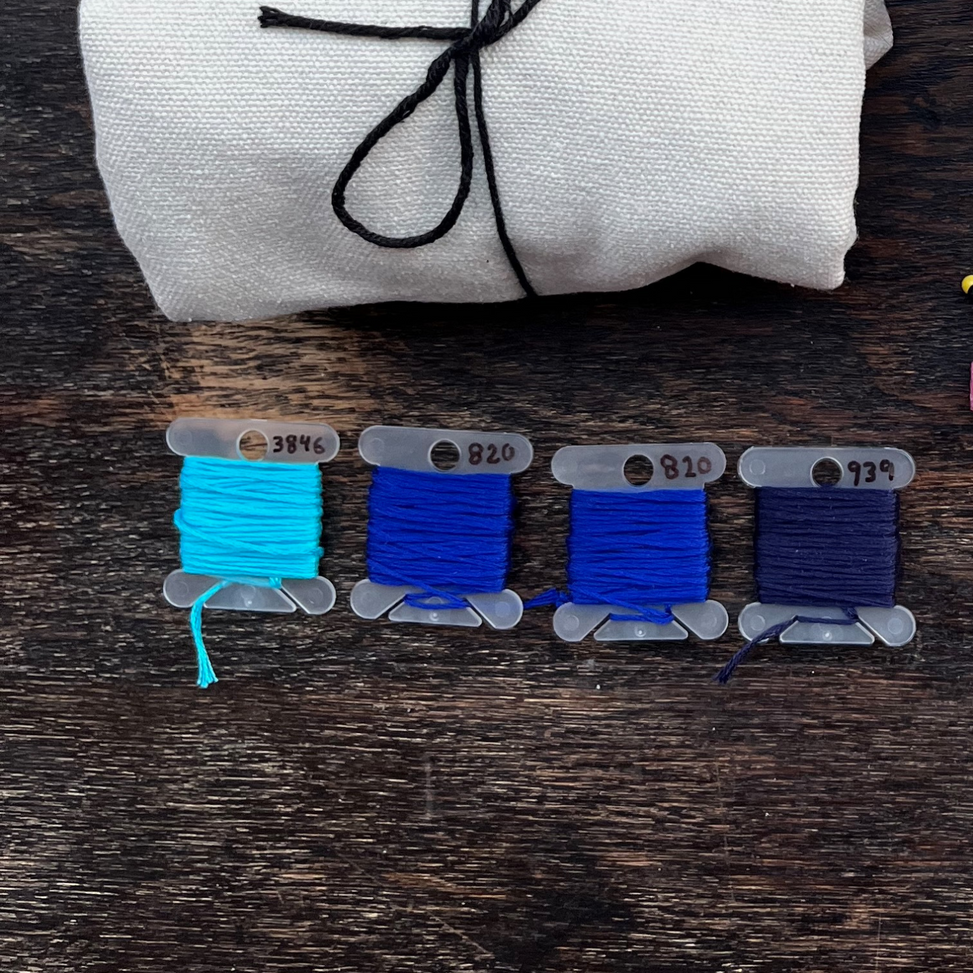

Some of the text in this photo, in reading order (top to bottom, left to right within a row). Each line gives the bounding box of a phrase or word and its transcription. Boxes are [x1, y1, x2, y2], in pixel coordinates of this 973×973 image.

[272, 434, 326, 455] 3846
[468, 442, 516, 465] 820
[660, 454, 712, 479] 820
[847, 459, 895, 486] 939
